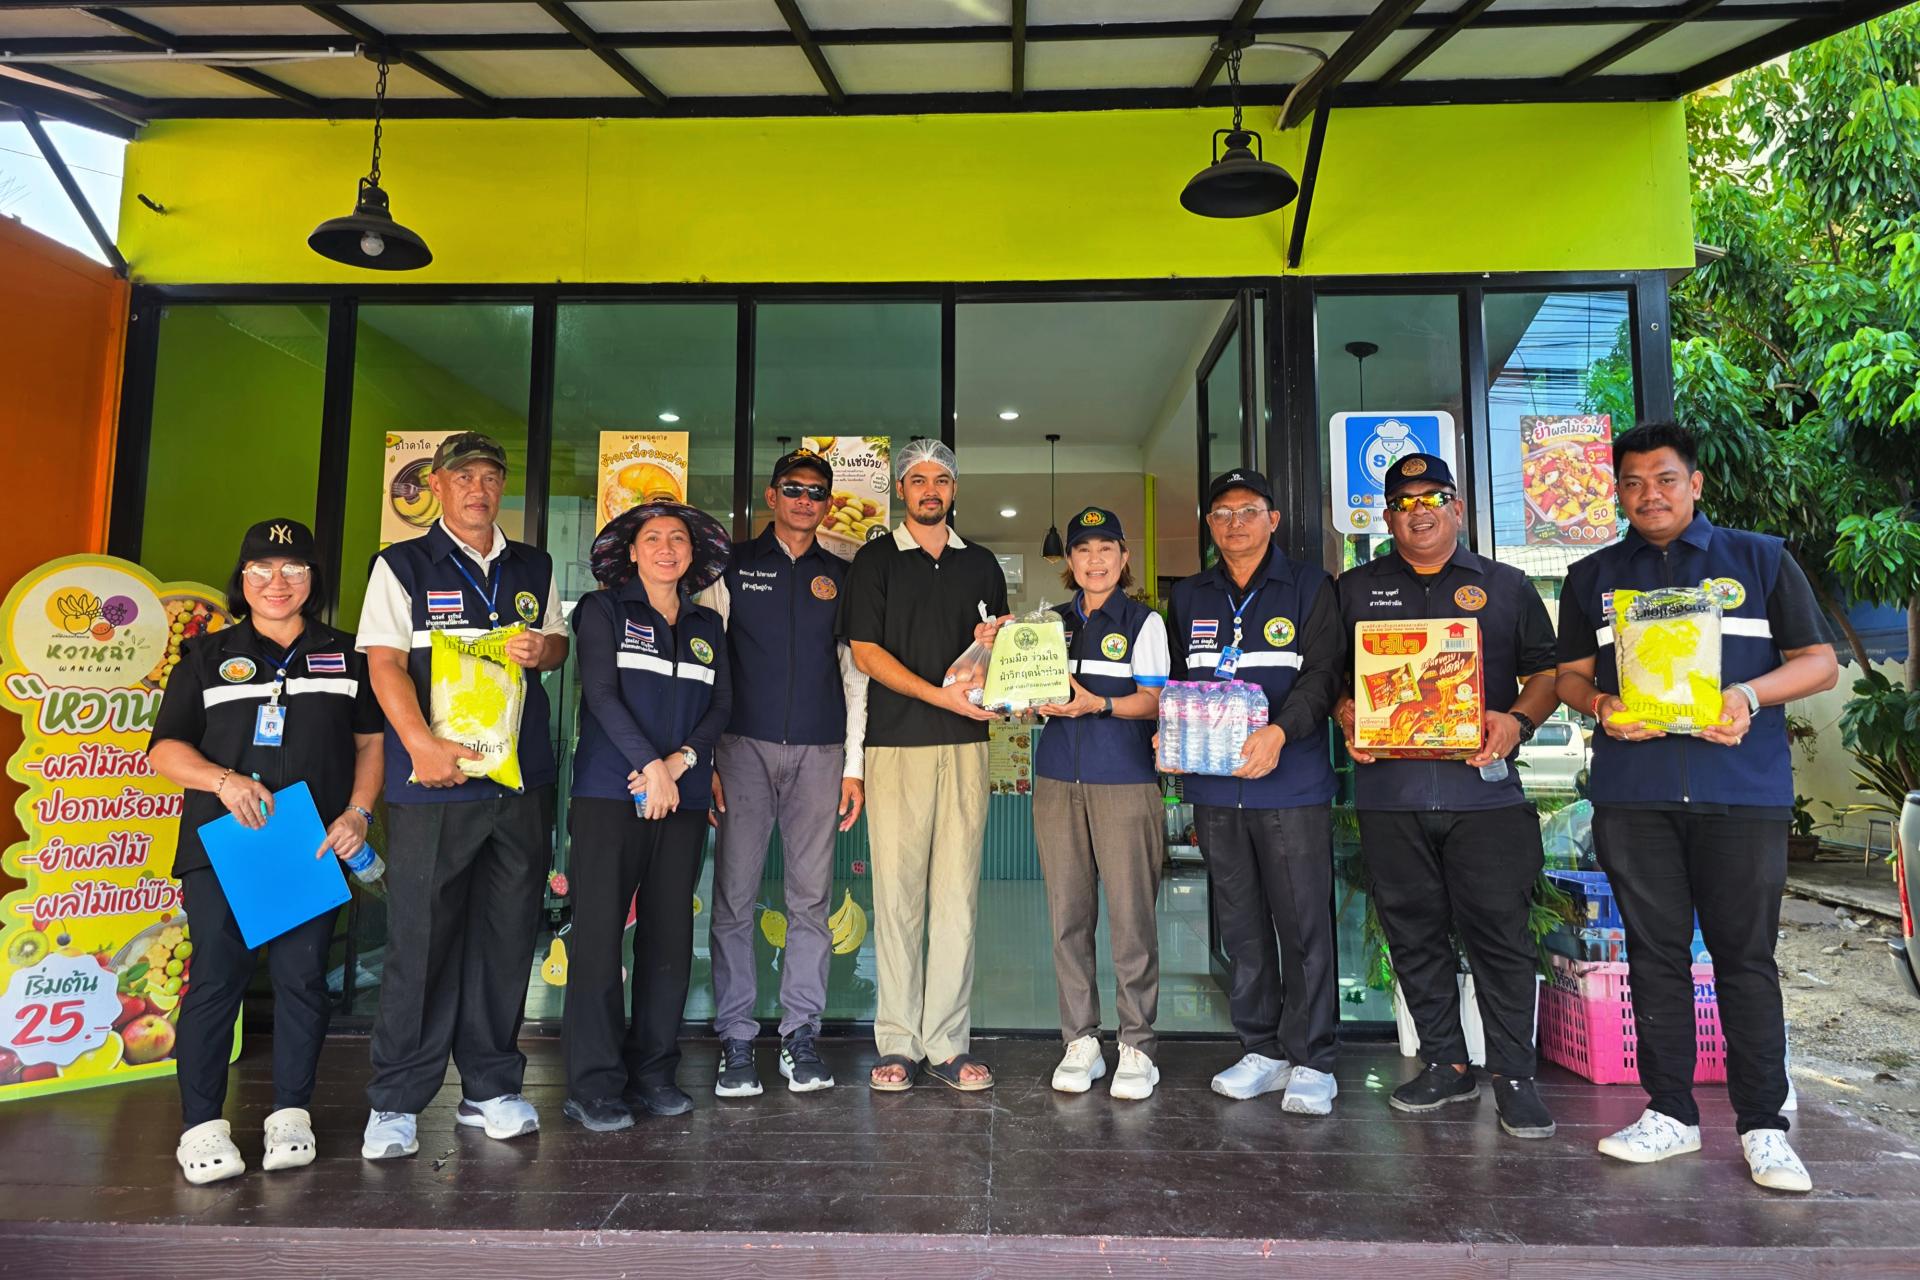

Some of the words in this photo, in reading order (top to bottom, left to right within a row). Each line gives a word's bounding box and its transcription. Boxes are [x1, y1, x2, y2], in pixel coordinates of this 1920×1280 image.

[1593, 507, 1608, 521] 50
[25, 966, 98, 996] เริ่มต้น
